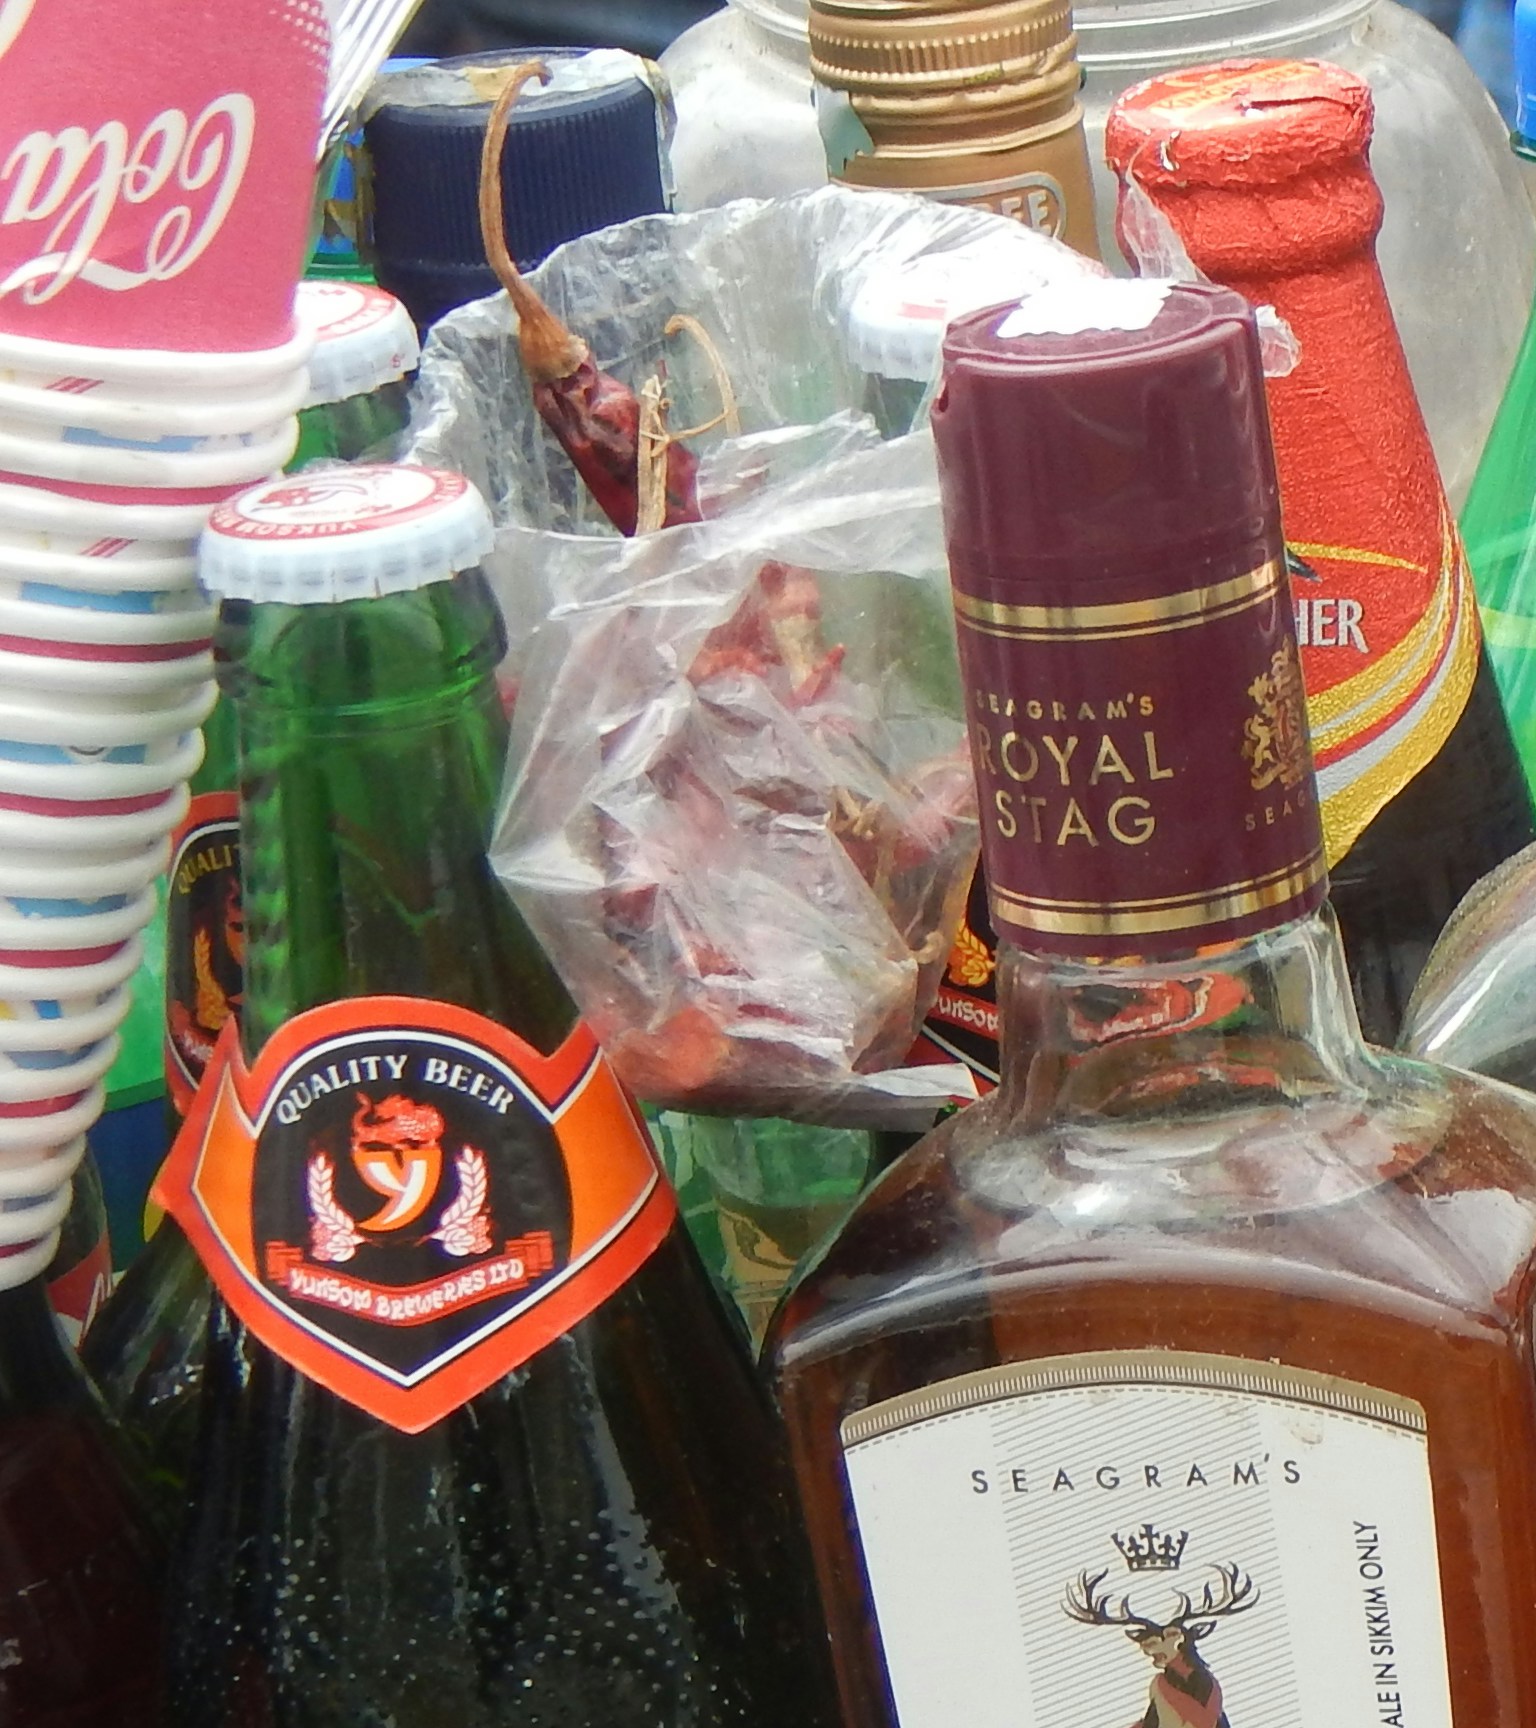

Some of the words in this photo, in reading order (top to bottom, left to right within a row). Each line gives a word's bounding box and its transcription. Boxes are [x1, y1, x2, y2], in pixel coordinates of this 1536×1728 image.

[976, 731, 1174, 787] ROYAL
[996, 789, 1156, 847] STAG
[274, 1055, 408, 1126] QUALITY
[425, 1056, 517, 1117] BEER
[488, 1257, 526, 1286] LTD
[971, 1452, 1302, 1496] SEAGRAM'S
[1353, 1520, 1384, 1580] ONLY
[1363, 1586, 1395, 1656] SIKKIM
[1373, 1663, 1399, 1685] IN
